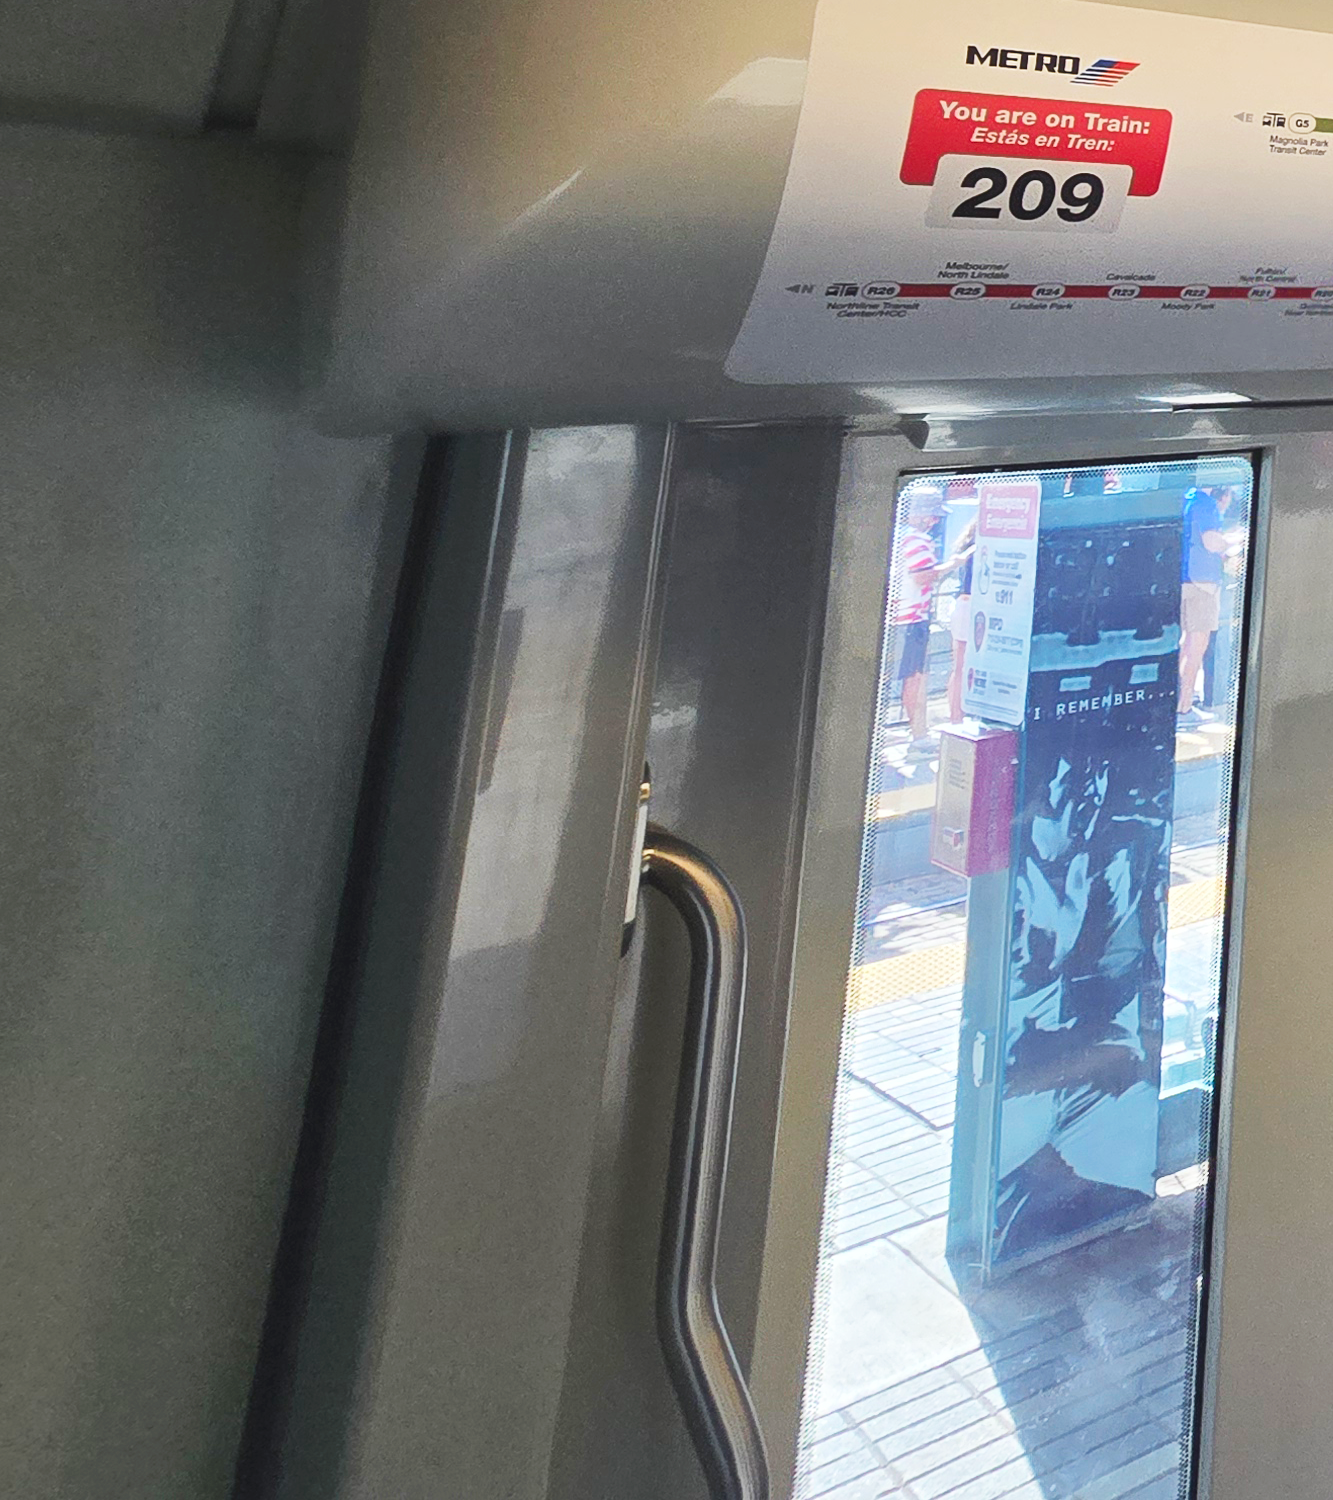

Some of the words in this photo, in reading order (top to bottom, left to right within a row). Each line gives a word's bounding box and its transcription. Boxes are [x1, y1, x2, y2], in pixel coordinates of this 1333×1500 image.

[965, 45, 1081, 75] METRO
[939, 100, 988, 122] You
[995, 109, 1037, 125] are
[1045, 113, 1075, 128] on
[1084, 112, 1151, 134] Train:
[1296, 118, 1310, 128] G5
[970, 126, 1029, 145] Estás
[1035, 133, 1060, 147] en
[1067, 134, 1115, 151] Tren:
[1270, 135, 1308, 147] Magnolia
[1309, 138, 1329, 147] Park
[1269, 145, 1297, 155] Transit
[1299, 147, 1327, 156] Center
[951, 167, 1105, 223] 209
[937, 270, 967, 279] North
[970, 271, 1009, 279] Lindale
[866, 285, 895, 296] R26
[954, 286, 981, 296] R25
[1035, 287, 1061, 297] R24
[1111, 288, 1136, 297] R23
[1183, 288, 1206, 297] R22
[1056, 689, 1175, 716] REMEMBER...
